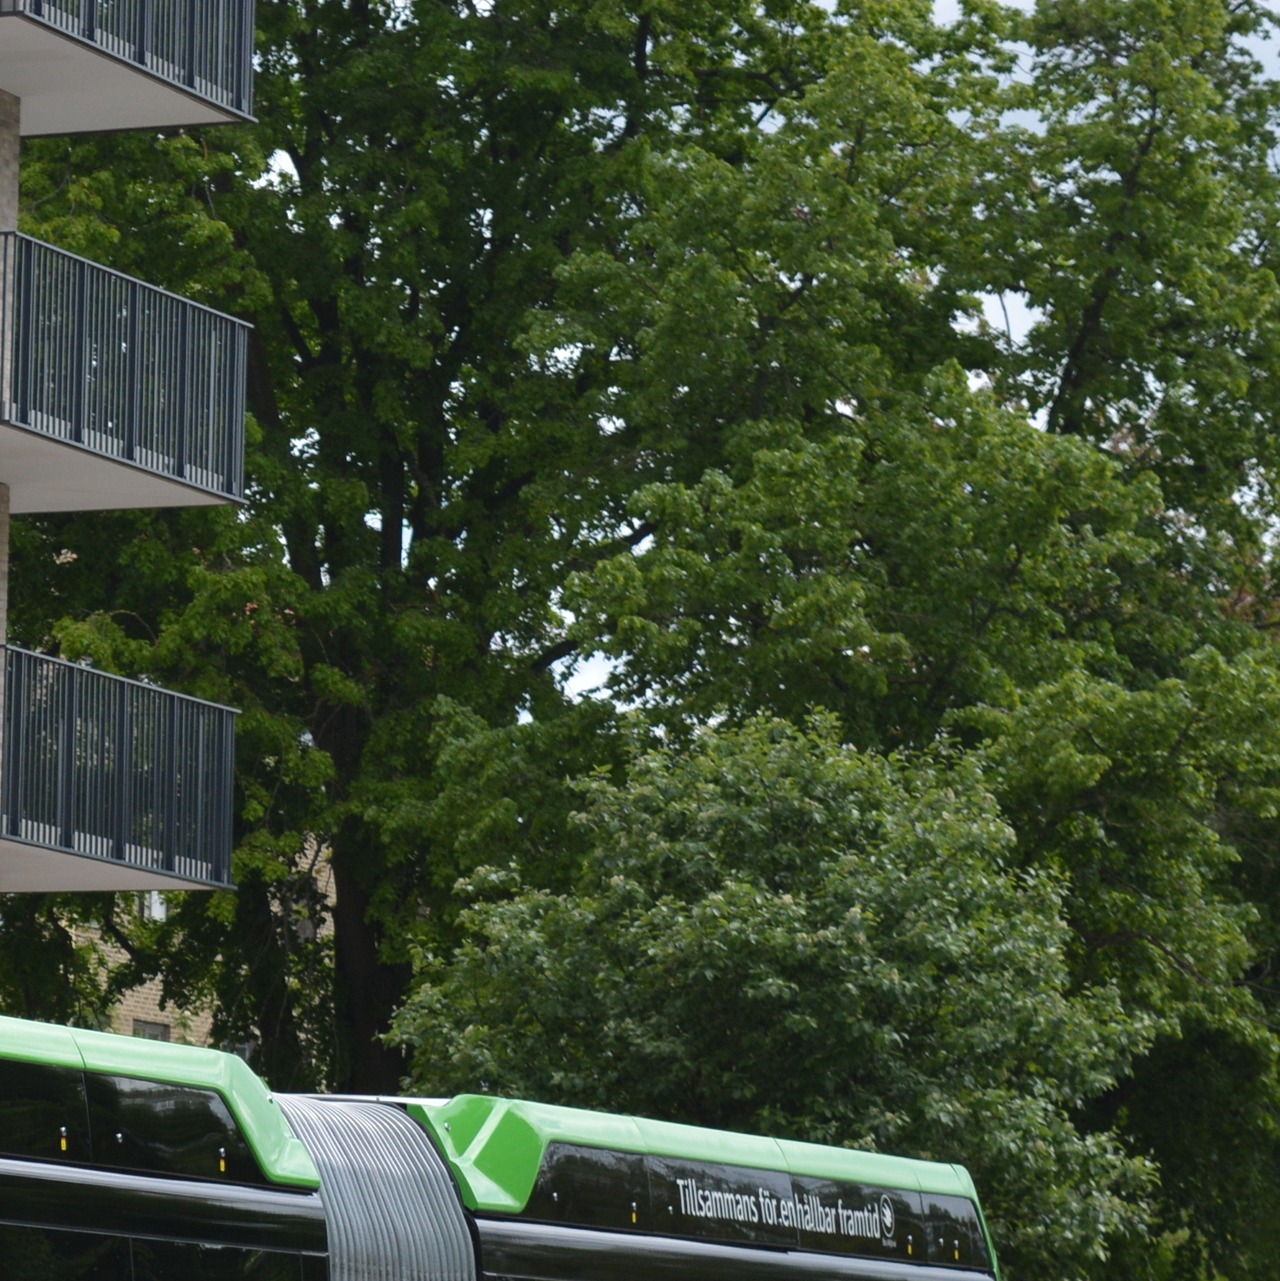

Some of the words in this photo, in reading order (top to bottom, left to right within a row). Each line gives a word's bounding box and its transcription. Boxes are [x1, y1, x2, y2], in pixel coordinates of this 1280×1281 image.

[676, 1178, 759, 1223] Tillsammans
[758, 1187, 779, 1226] för
[780, 1200, 798, 1230] en
[794, 1193, 837, 1234] hållbar
[837, 1198, 881, 1239] framtid
